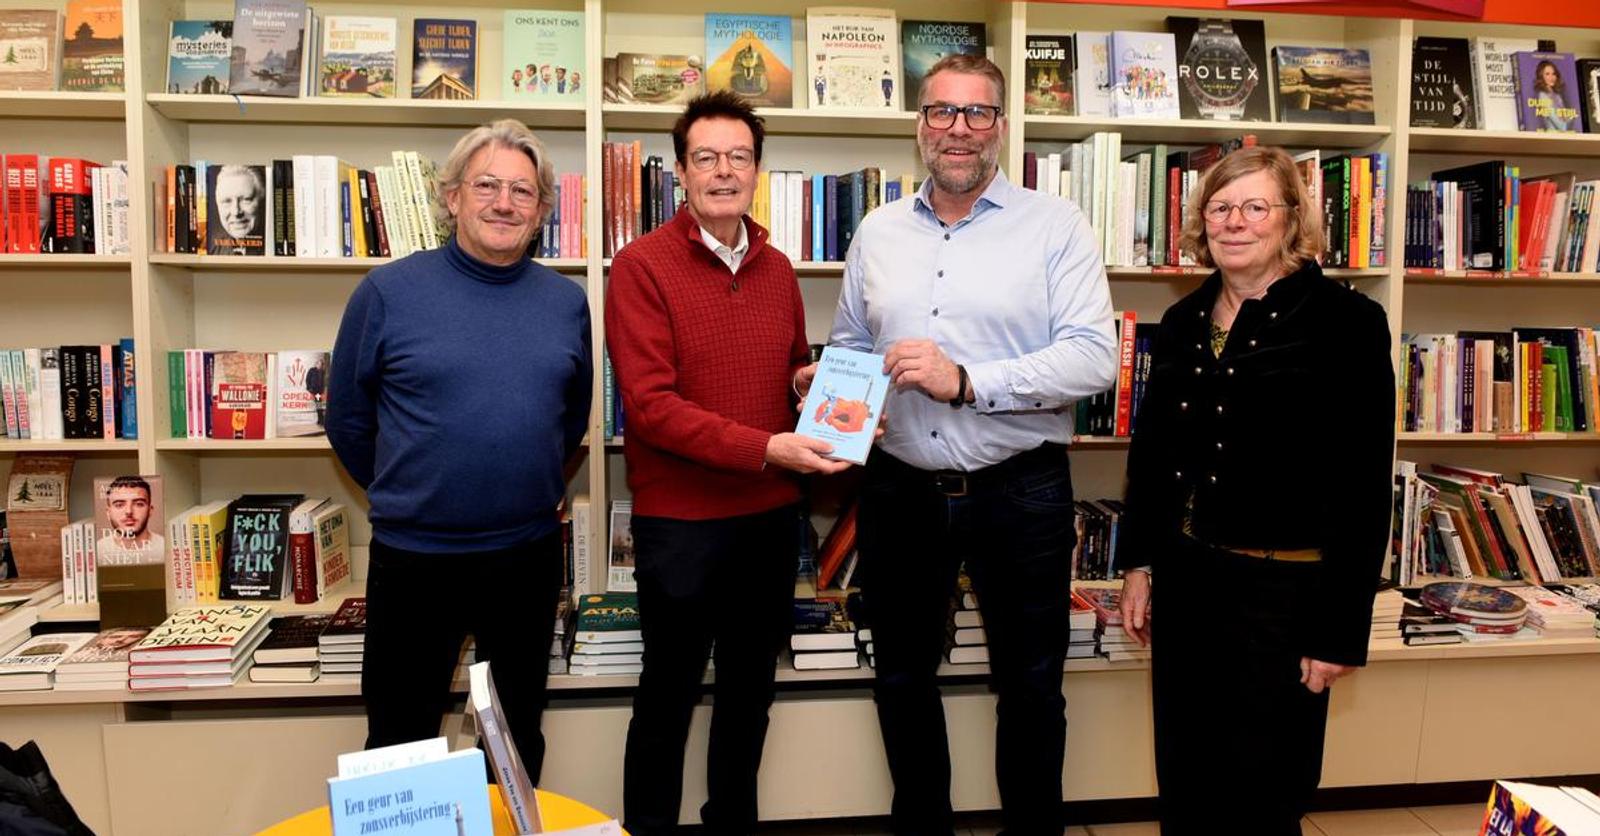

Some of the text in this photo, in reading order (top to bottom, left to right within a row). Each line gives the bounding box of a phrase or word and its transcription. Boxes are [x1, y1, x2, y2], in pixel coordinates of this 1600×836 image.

[515, 17, 580, 27] ONS KENT ONS
[715, 18, 781, 31] EGYPTISCHE
[713, 29, 783, 42] MYTHOLOGIE
[919, 24, 970, 36] NOORDSE
[822, 32, 885, 42] NAPOLEON
[912, 35, 978, 46] MYTHOLOGIE
[1025, 49, 1066, 60] KUIFJE
[1425, 60, 1442, 70] DE
[1179, 65, 1259, 80] ROLEX
[1414, 74, 1451, 84] STIJL
[1487, 74, 1514, 84] EXPENS
[1419, 87, 1443, 97] VAN
[1488, 84, 1515, 95] WATCHE
[1414, 100, 1446, 112] TIJD
[1122, 340, 1133, 367] CASH
[123, 350, 135, 388] ATLAS
[64, 387, 79, 422] Congo
[85, 387, 101, 422] Congo
[102, 528, 136, 540] DOE
[578, 535, 585, 544] DE
[173, 548, 183, 589] SPECTRUM
[184, 548, 194, 589] SPECTRUM
[234, 554, 275, 572] FLIK
[294, 546, 303, 590] MONARCHIE
[583, 607, 638, 616] ATLA
[344, 789, 414, 817] Een geur van
[360, 801, 451, 835] zonsverbijstering
